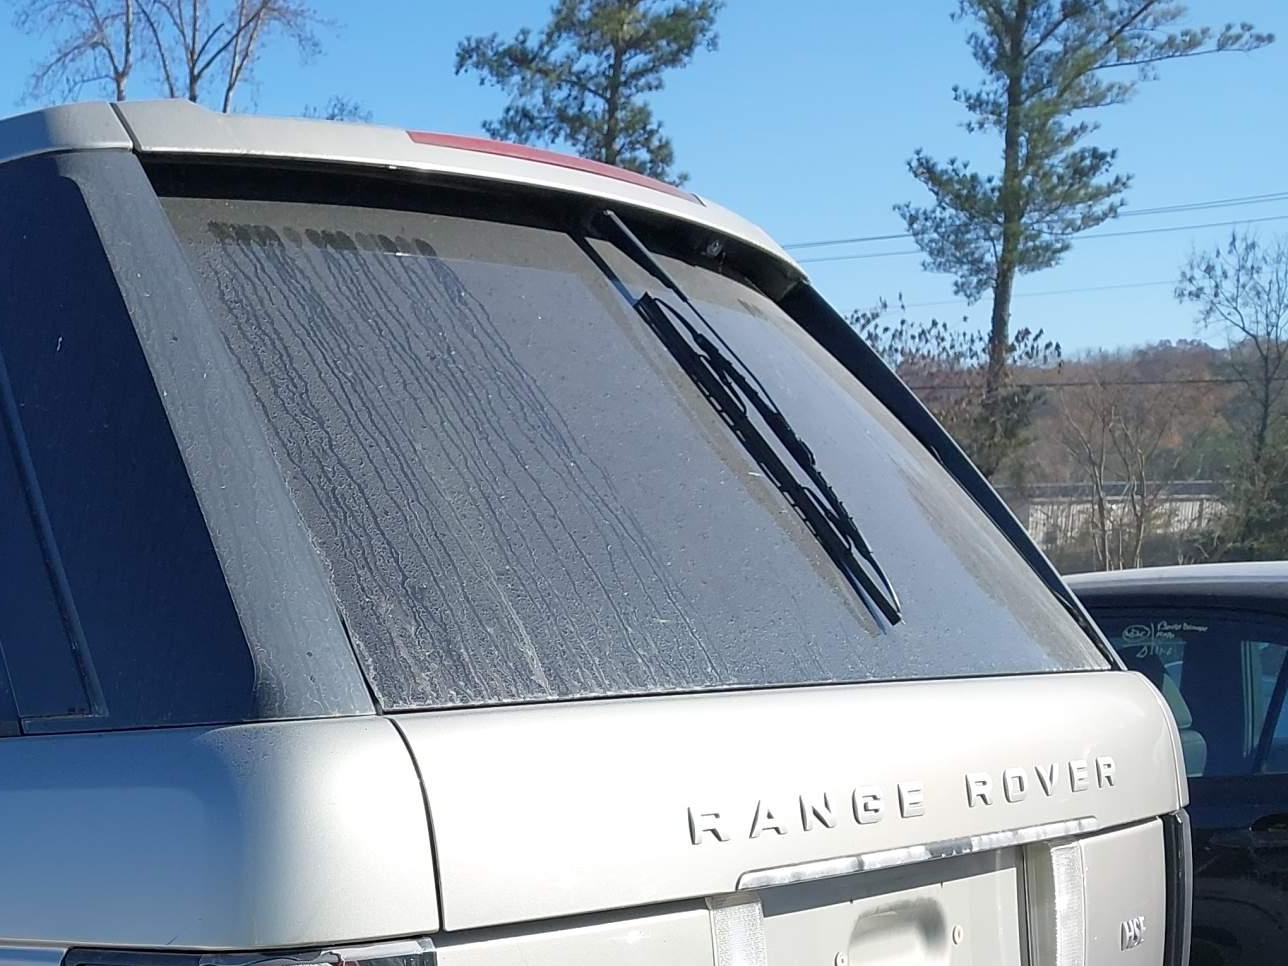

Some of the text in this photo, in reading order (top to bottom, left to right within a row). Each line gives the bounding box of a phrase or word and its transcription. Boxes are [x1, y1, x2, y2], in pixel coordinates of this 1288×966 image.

[687, 755, 1118, 846] RANGE ROVER
[1120, 915, 1146, 951] HSE
